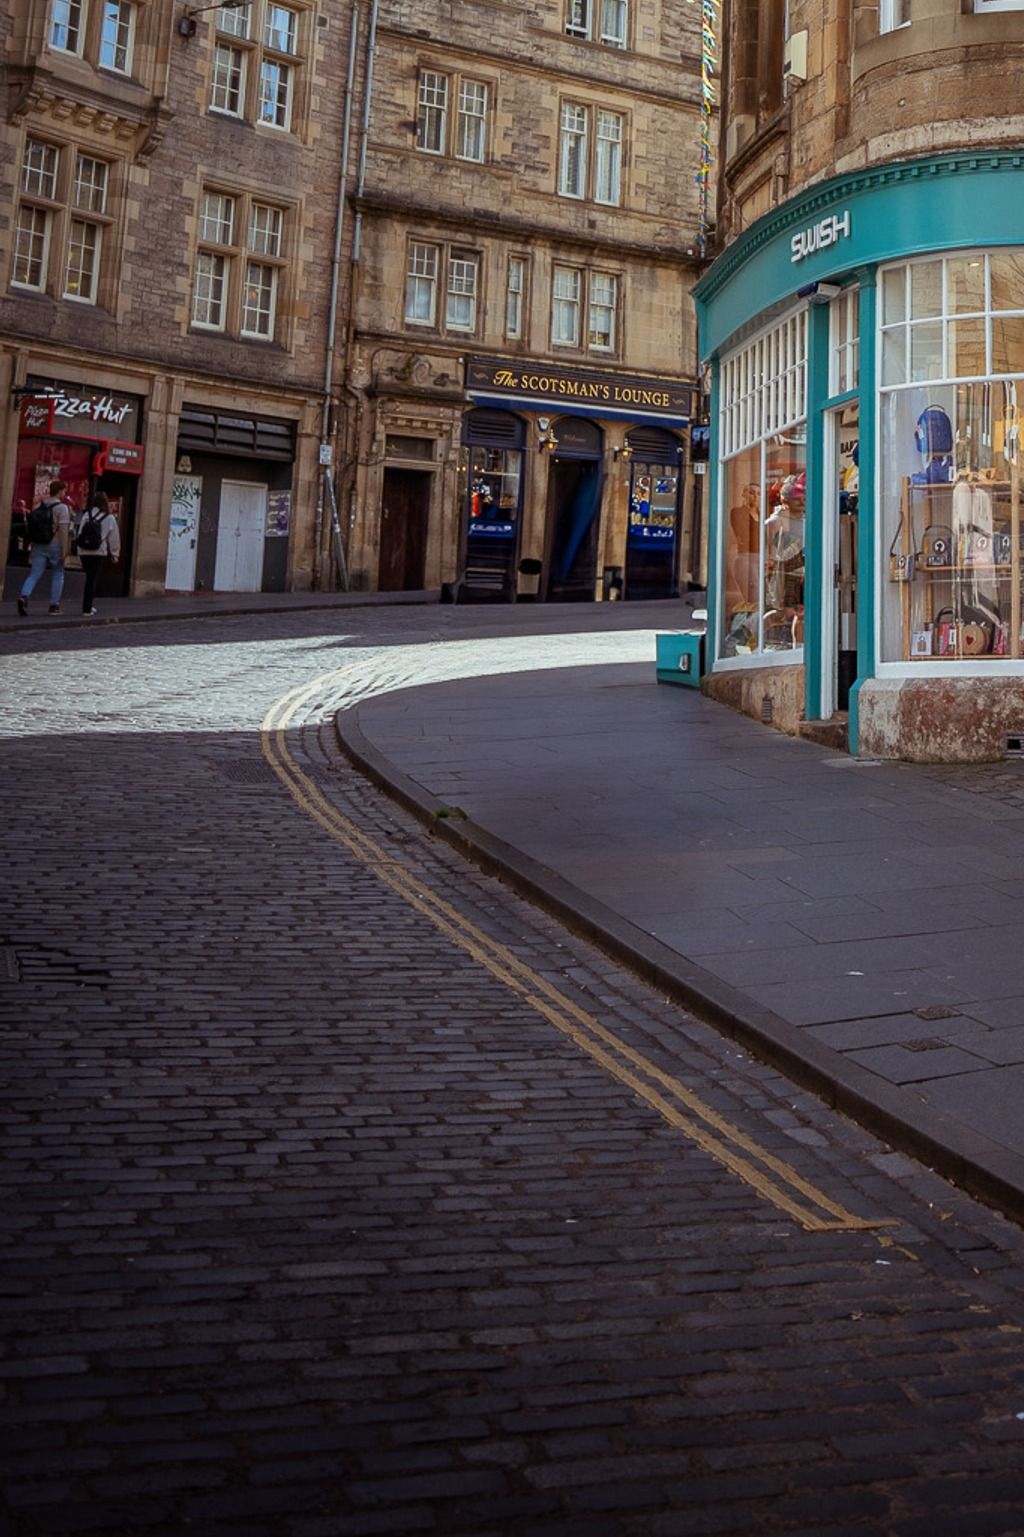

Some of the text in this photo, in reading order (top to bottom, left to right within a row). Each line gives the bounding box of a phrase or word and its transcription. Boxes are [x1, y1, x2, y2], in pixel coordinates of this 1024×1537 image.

[791, 210, 850, 263] SWISH
[493, 370, 670, 407] The SCOTSMAN'S LOUNGE
[24, 404, 49, 418] Pizza
[26, 416, 44, 427] Hut
[91, 395, 134, 425] Hut
